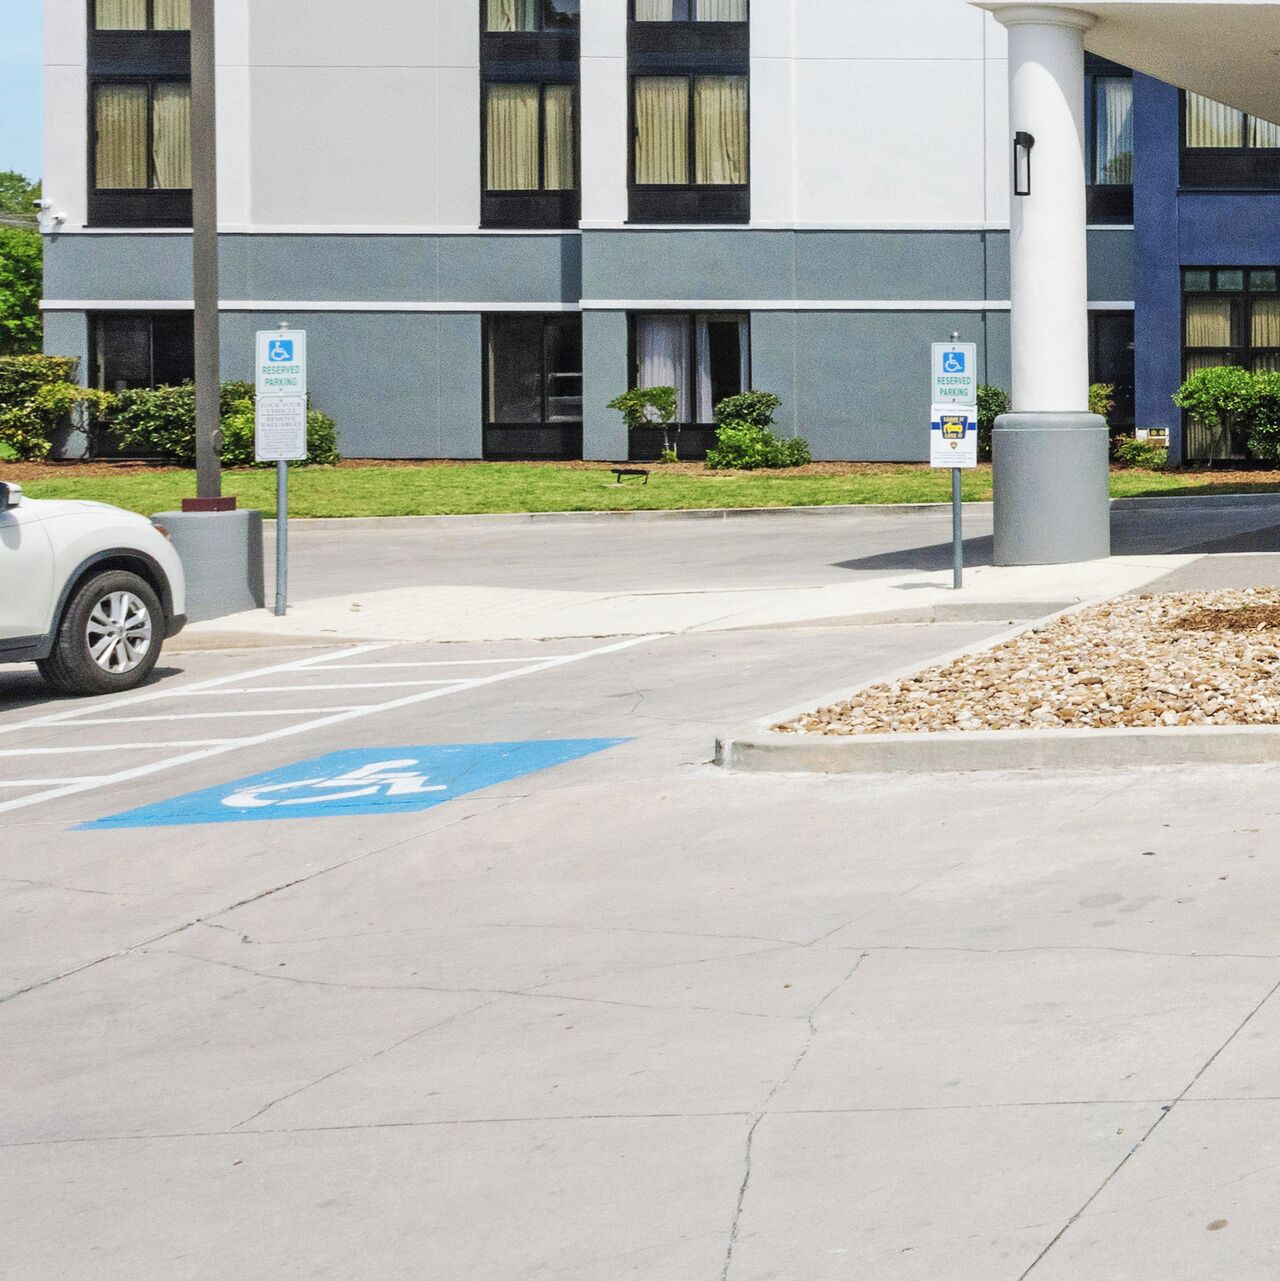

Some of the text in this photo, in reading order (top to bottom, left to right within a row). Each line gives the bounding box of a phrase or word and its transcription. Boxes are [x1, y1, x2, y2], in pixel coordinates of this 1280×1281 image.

[261, 365, 300, 375] RESERVED
[264, 377, 298, 387] PARKING
[936, 376, 971, 385] RESERVED
[939, 387, 969, 397] PARKING
